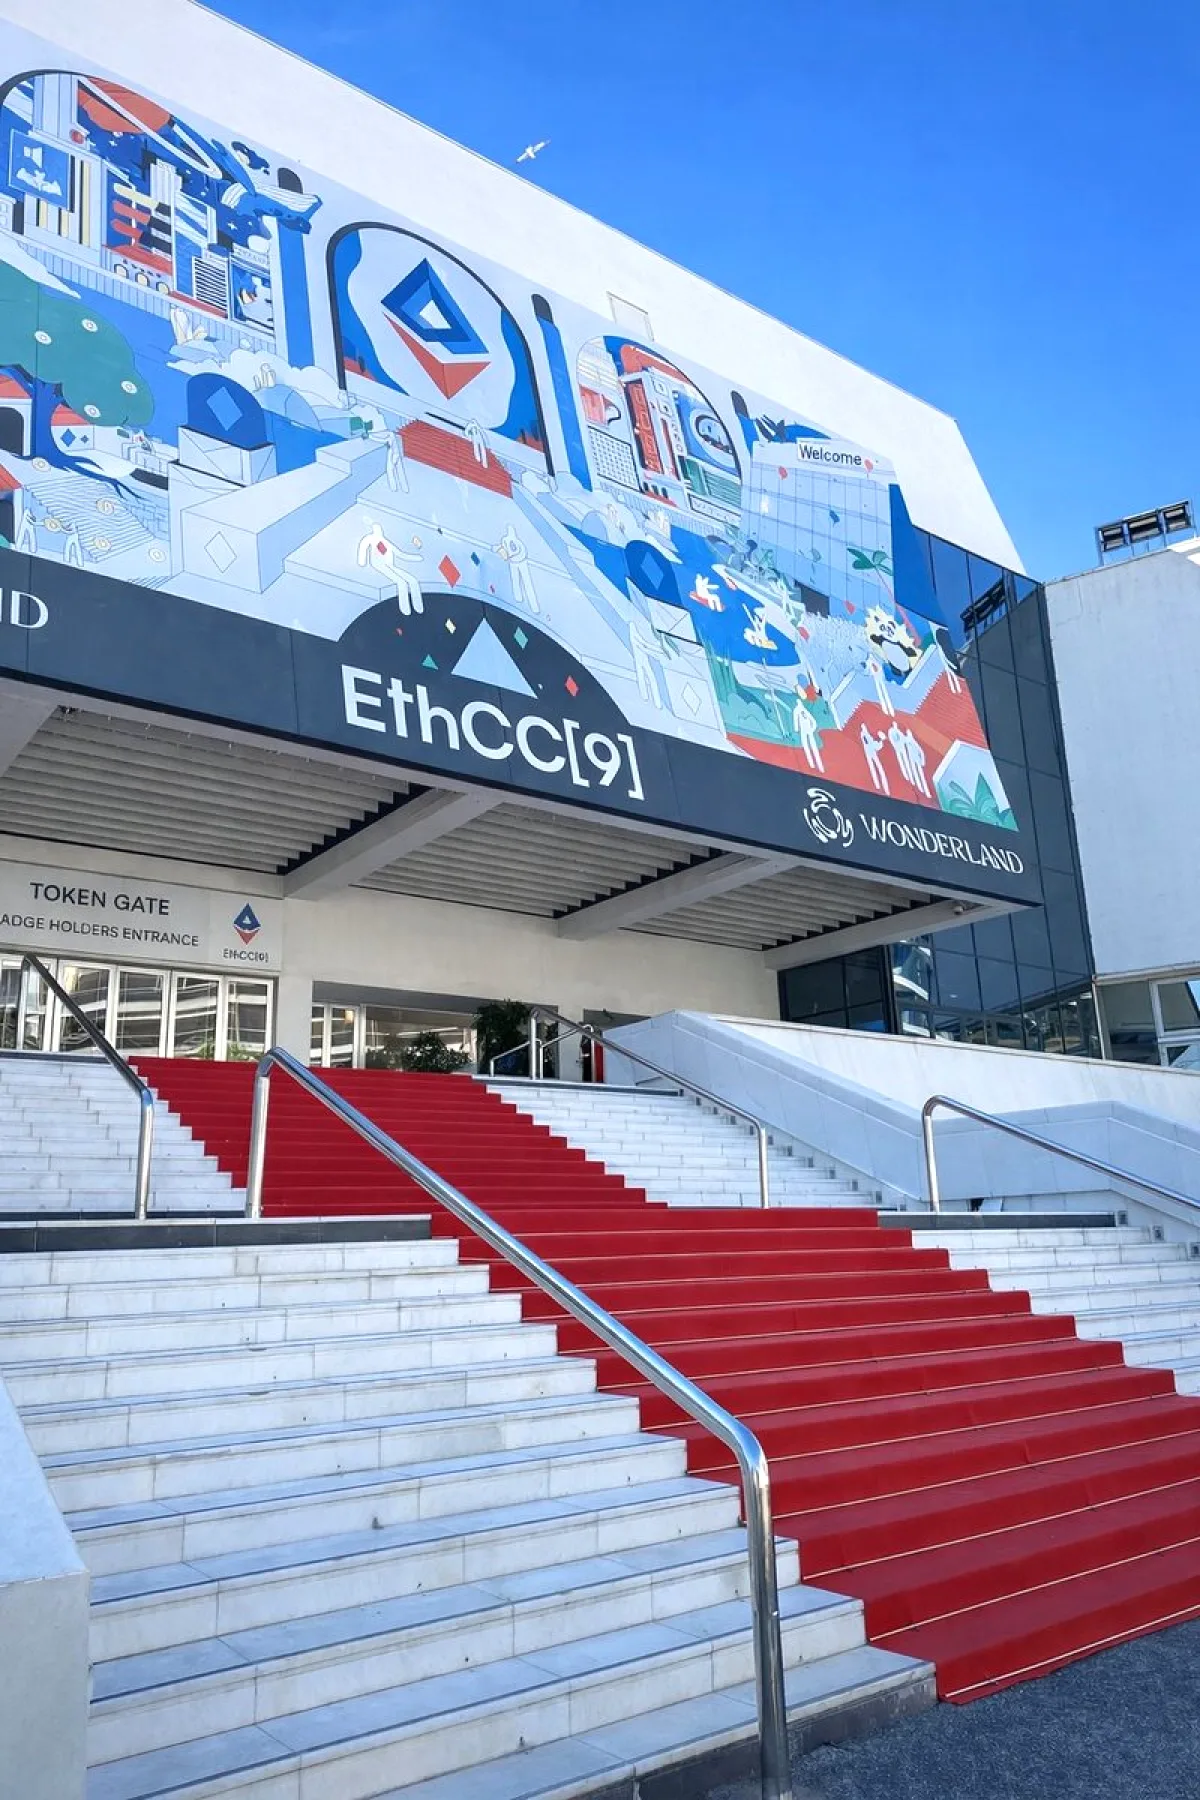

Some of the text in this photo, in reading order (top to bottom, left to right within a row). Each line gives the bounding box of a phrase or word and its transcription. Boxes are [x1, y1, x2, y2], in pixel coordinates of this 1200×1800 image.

[799, 444, 862, 465] Welcome
[341, 664, 645, 801] EthCC[9]
[859, 813, 1024, 874] WONDERLAND
[29, 882, 171, 916] TOKEN GATE
[49, 919, 119, 938] HOLDERS
[122, 929, 199, 946] ENTRANCE
